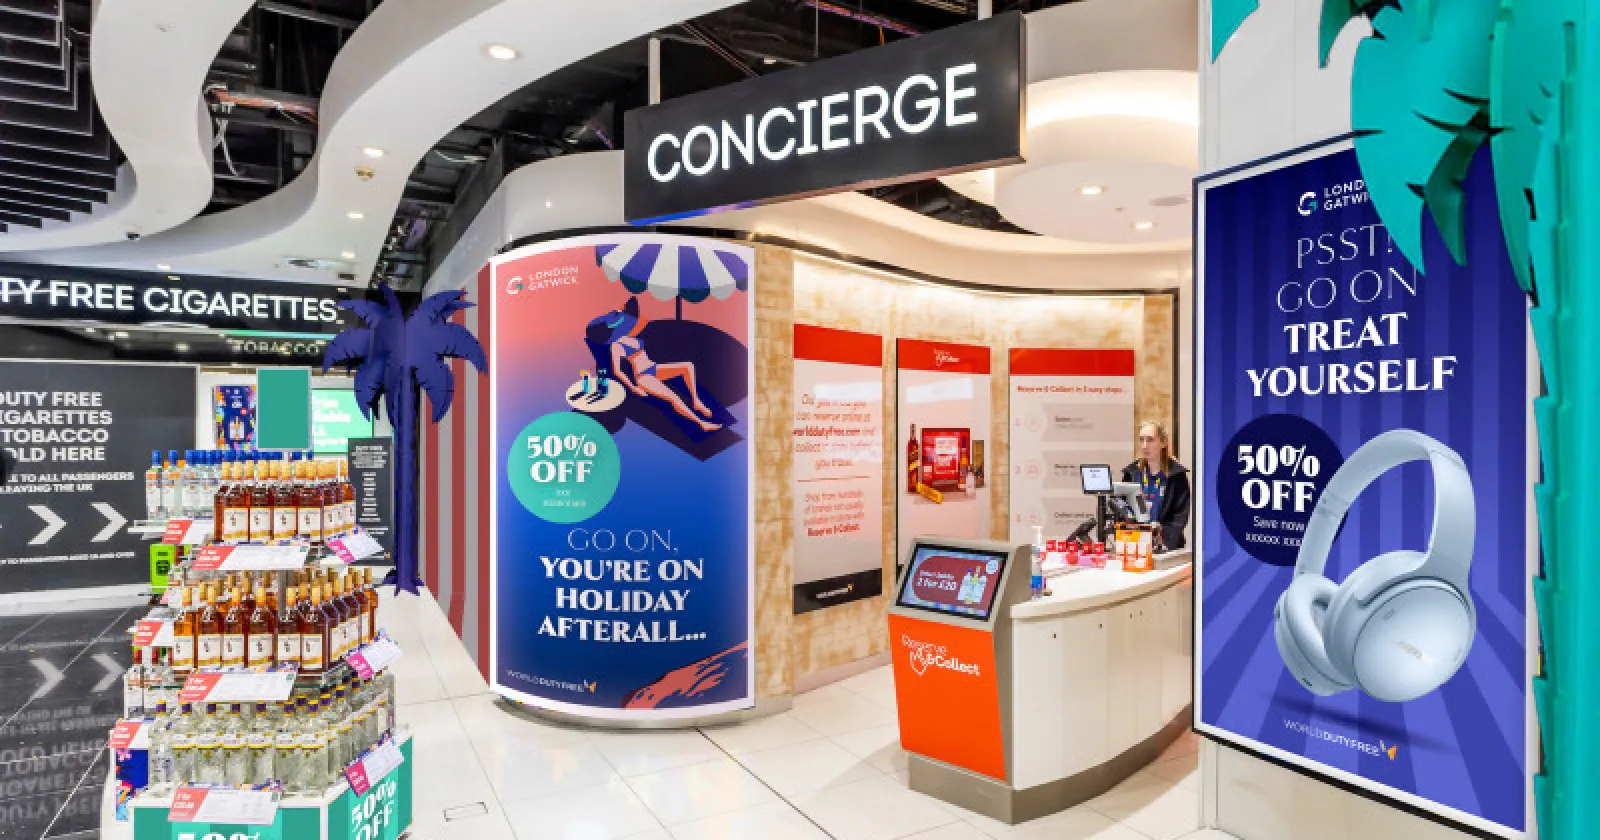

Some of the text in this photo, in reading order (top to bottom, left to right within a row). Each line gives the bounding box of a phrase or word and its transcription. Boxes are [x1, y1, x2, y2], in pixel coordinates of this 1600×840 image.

[648, 63, 978, 182] CONCIERGE
[1323, 179, 1365, 198] LOND
[1323, 192, 1369, 210] GATWI
[1297, 223, 1393, 269] PSST!
[528, 266, 579, 281] LONDON
[528, 276, 578, 290] GATWICK
[50, 281, 135, 310] FREE
[143, 287, 338, 322] CIGARETTES
[1277, 267, 1417, 313] GO ON
[1284, 312, 1408, 354] TREAT
[234, 339, 320, 356] TOBACCO
[1246, 355, 1458, 397] YOURSELF
[52, 391, 102, 407] FREE
[0, 428, 109, 443] TOBACCO
[527, 433, 597, 458] 50%
[52, 446, 105, 461] HERE
[1237, 443, 1321, 478] 50%
[530, 460, 594, 483] OFF
[1241, 478, 1316, 512] OFF
[1253, 515, 1279, 529] Save
[567, 528, 679, 555] GO ON,
[540, 556, 705, 582] YOU'RE ON
[555, 587, 690, 613] HOLIDAY
[902, 634, 948, 656] Reserve
[351, 778, 397, 827] 50%
